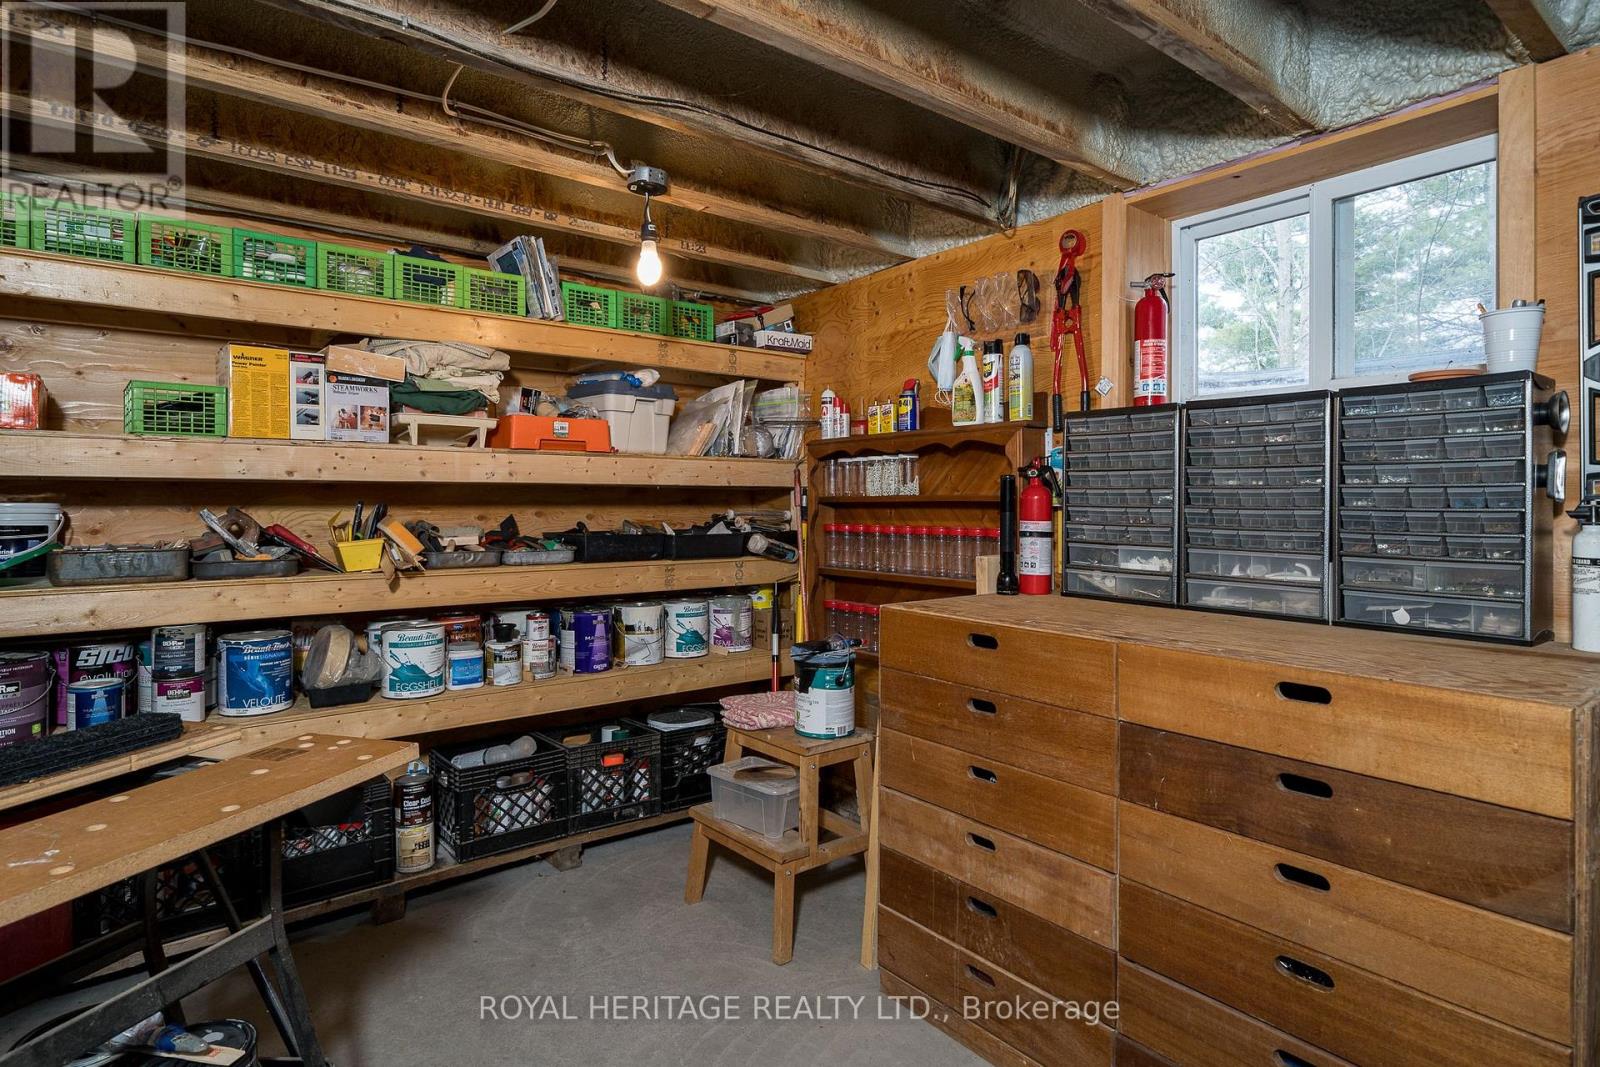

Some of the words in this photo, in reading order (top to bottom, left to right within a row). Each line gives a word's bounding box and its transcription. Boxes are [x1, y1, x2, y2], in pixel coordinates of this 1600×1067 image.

[767, 335, 811, 349] KraftMaid
[396, 679, 439, 692] EGGSHELL
[243, 691, 286, 708] VELOUTÉ
